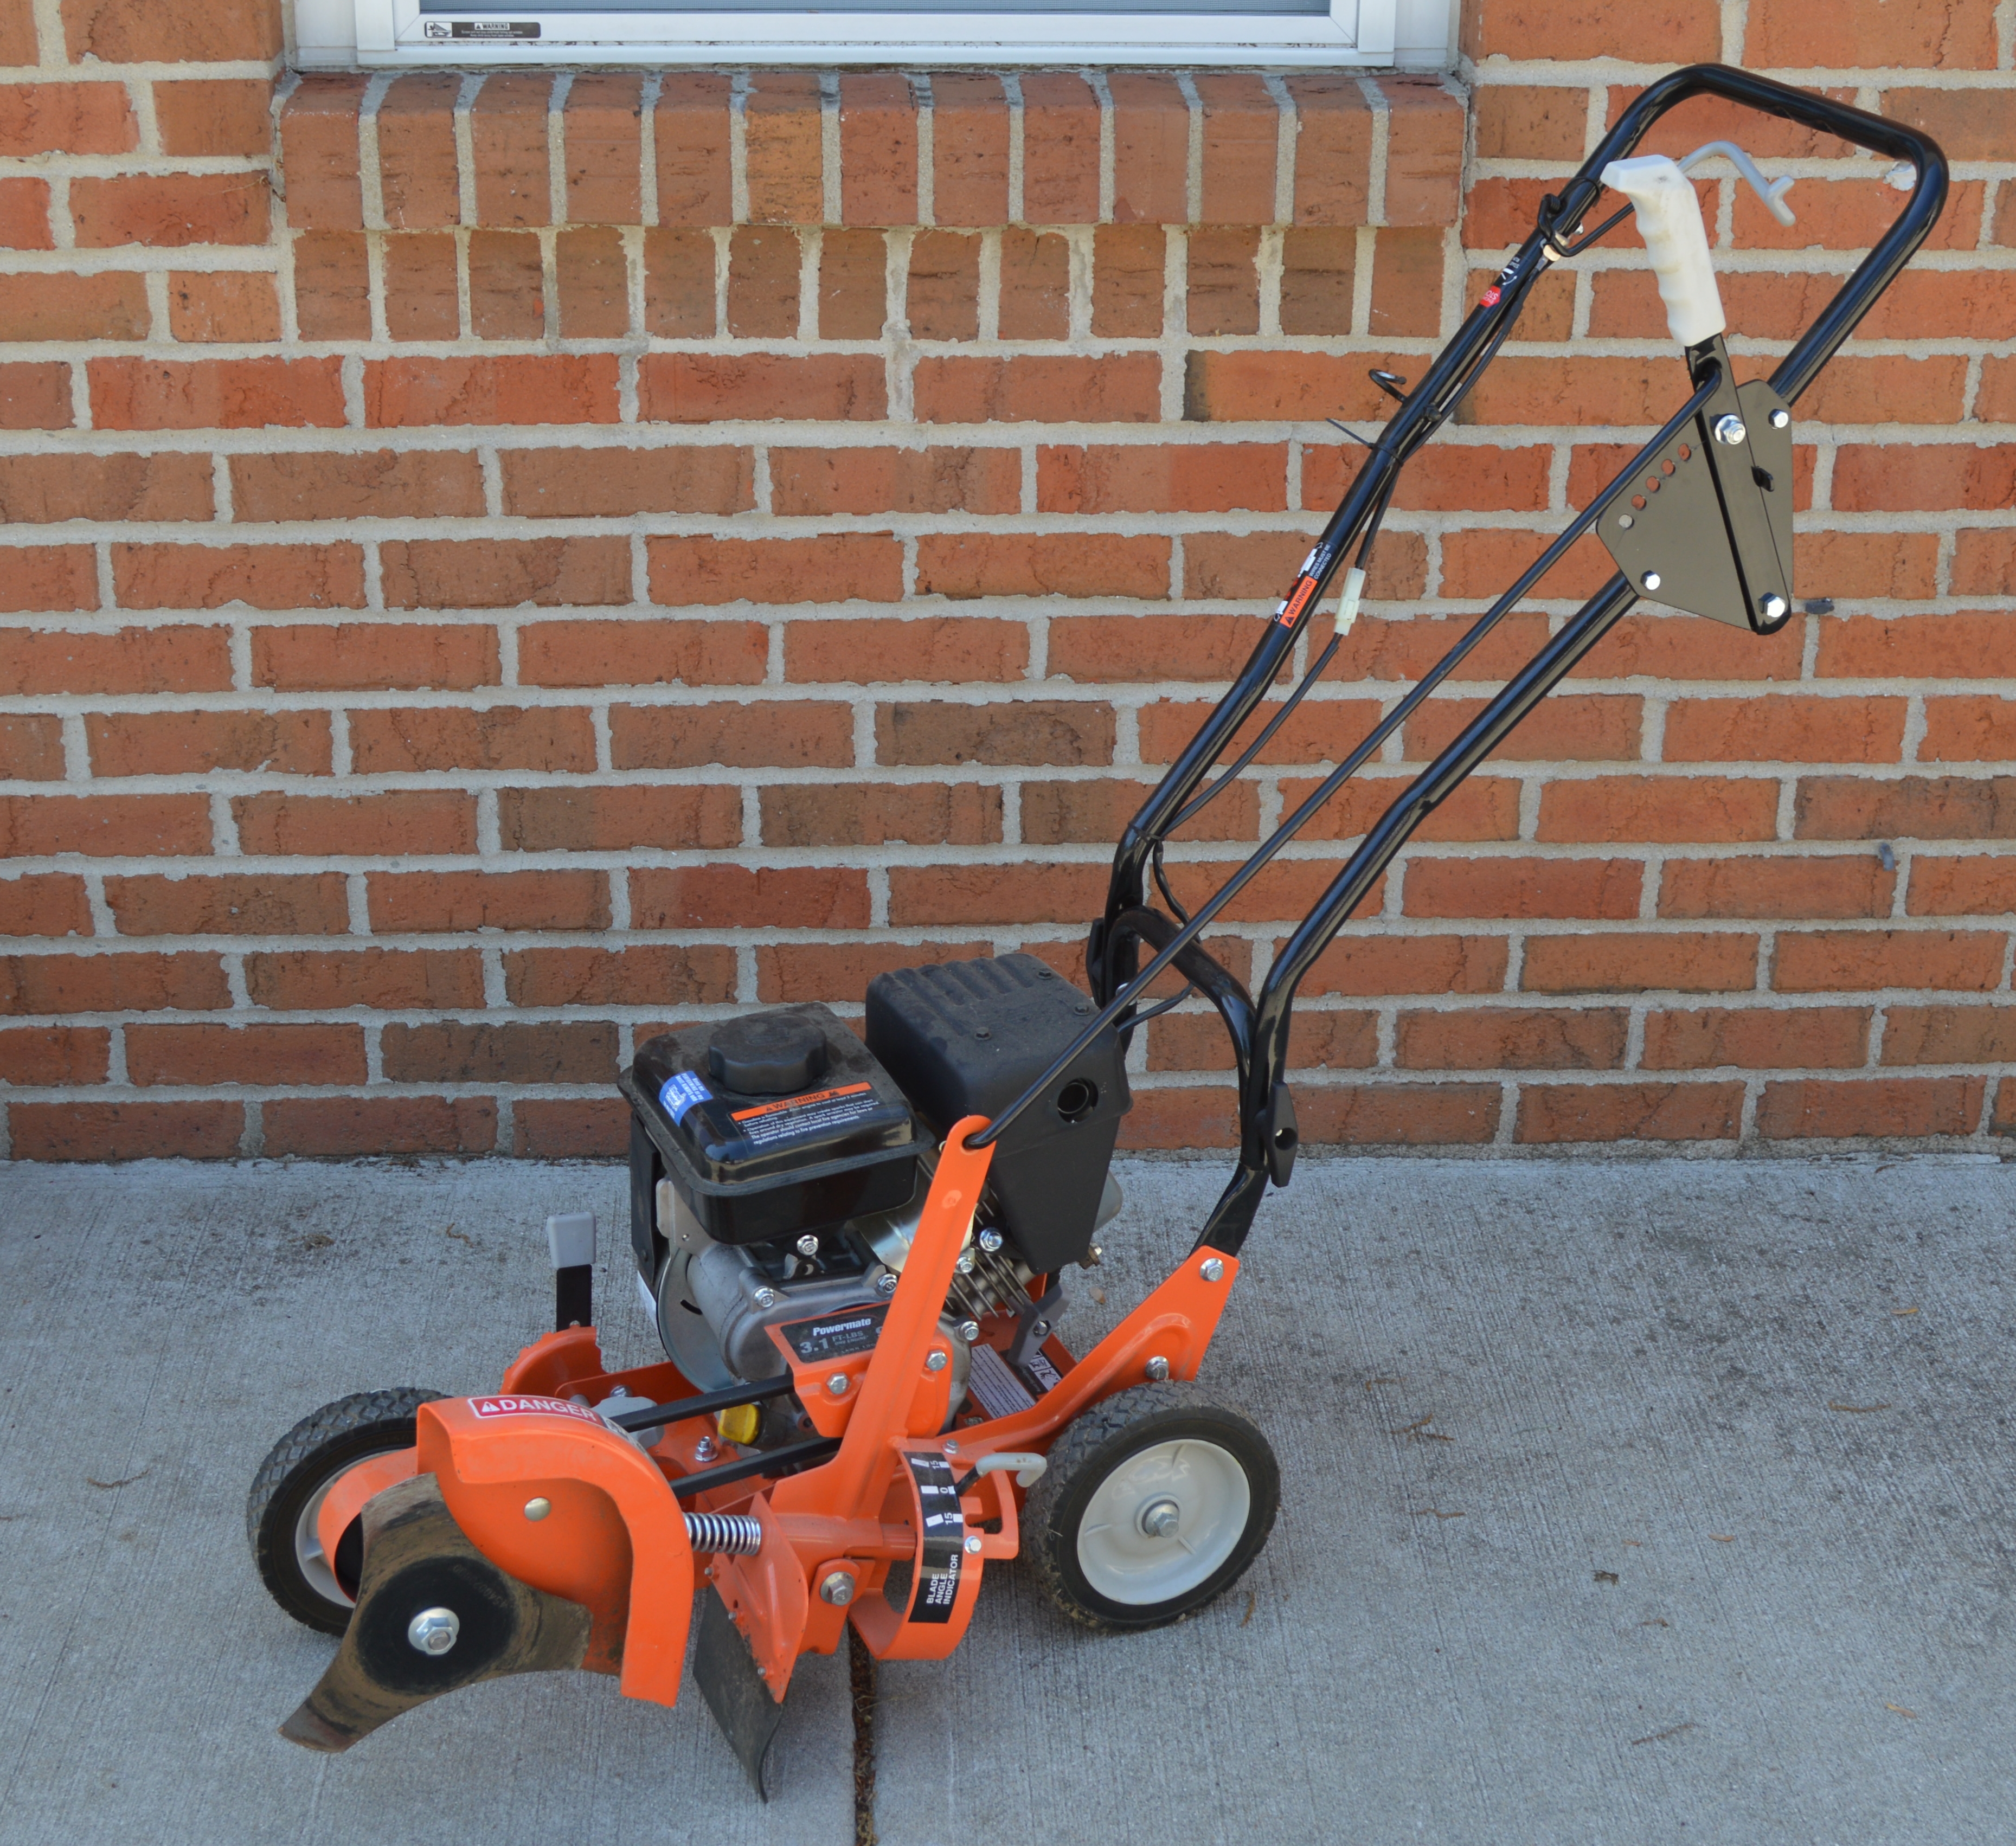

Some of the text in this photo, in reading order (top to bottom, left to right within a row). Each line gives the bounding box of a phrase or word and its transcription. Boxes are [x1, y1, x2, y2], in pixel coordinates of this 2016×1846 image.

[1309, 563, 1320, 576] WIRES
[1317, 550, 1326, 563] MUST
[1314, 553, 1331, 579] CONNECTED
[1288, 581, 1312, 614] WARNING
[773, 1094, 825, 1109] WARNING
[754, 1136, 778, 1144] regulations
[808, 1122, 831, 1131] prevention
[813, 1318, 871, 1336] Powermate
[800, 1330, 863, 1353] 3.1 FT-LBS
[499, 1398, 596, 1422] DANGER
[930, 1459, 939, 1469] 15
[944, 1512, 953, 1525] 15
[926, 1573, 940, 1604] BLADE
[935, 1573, 948, 1604] ANGLE
[942, 1554, 959, 1605] INDICATOR
